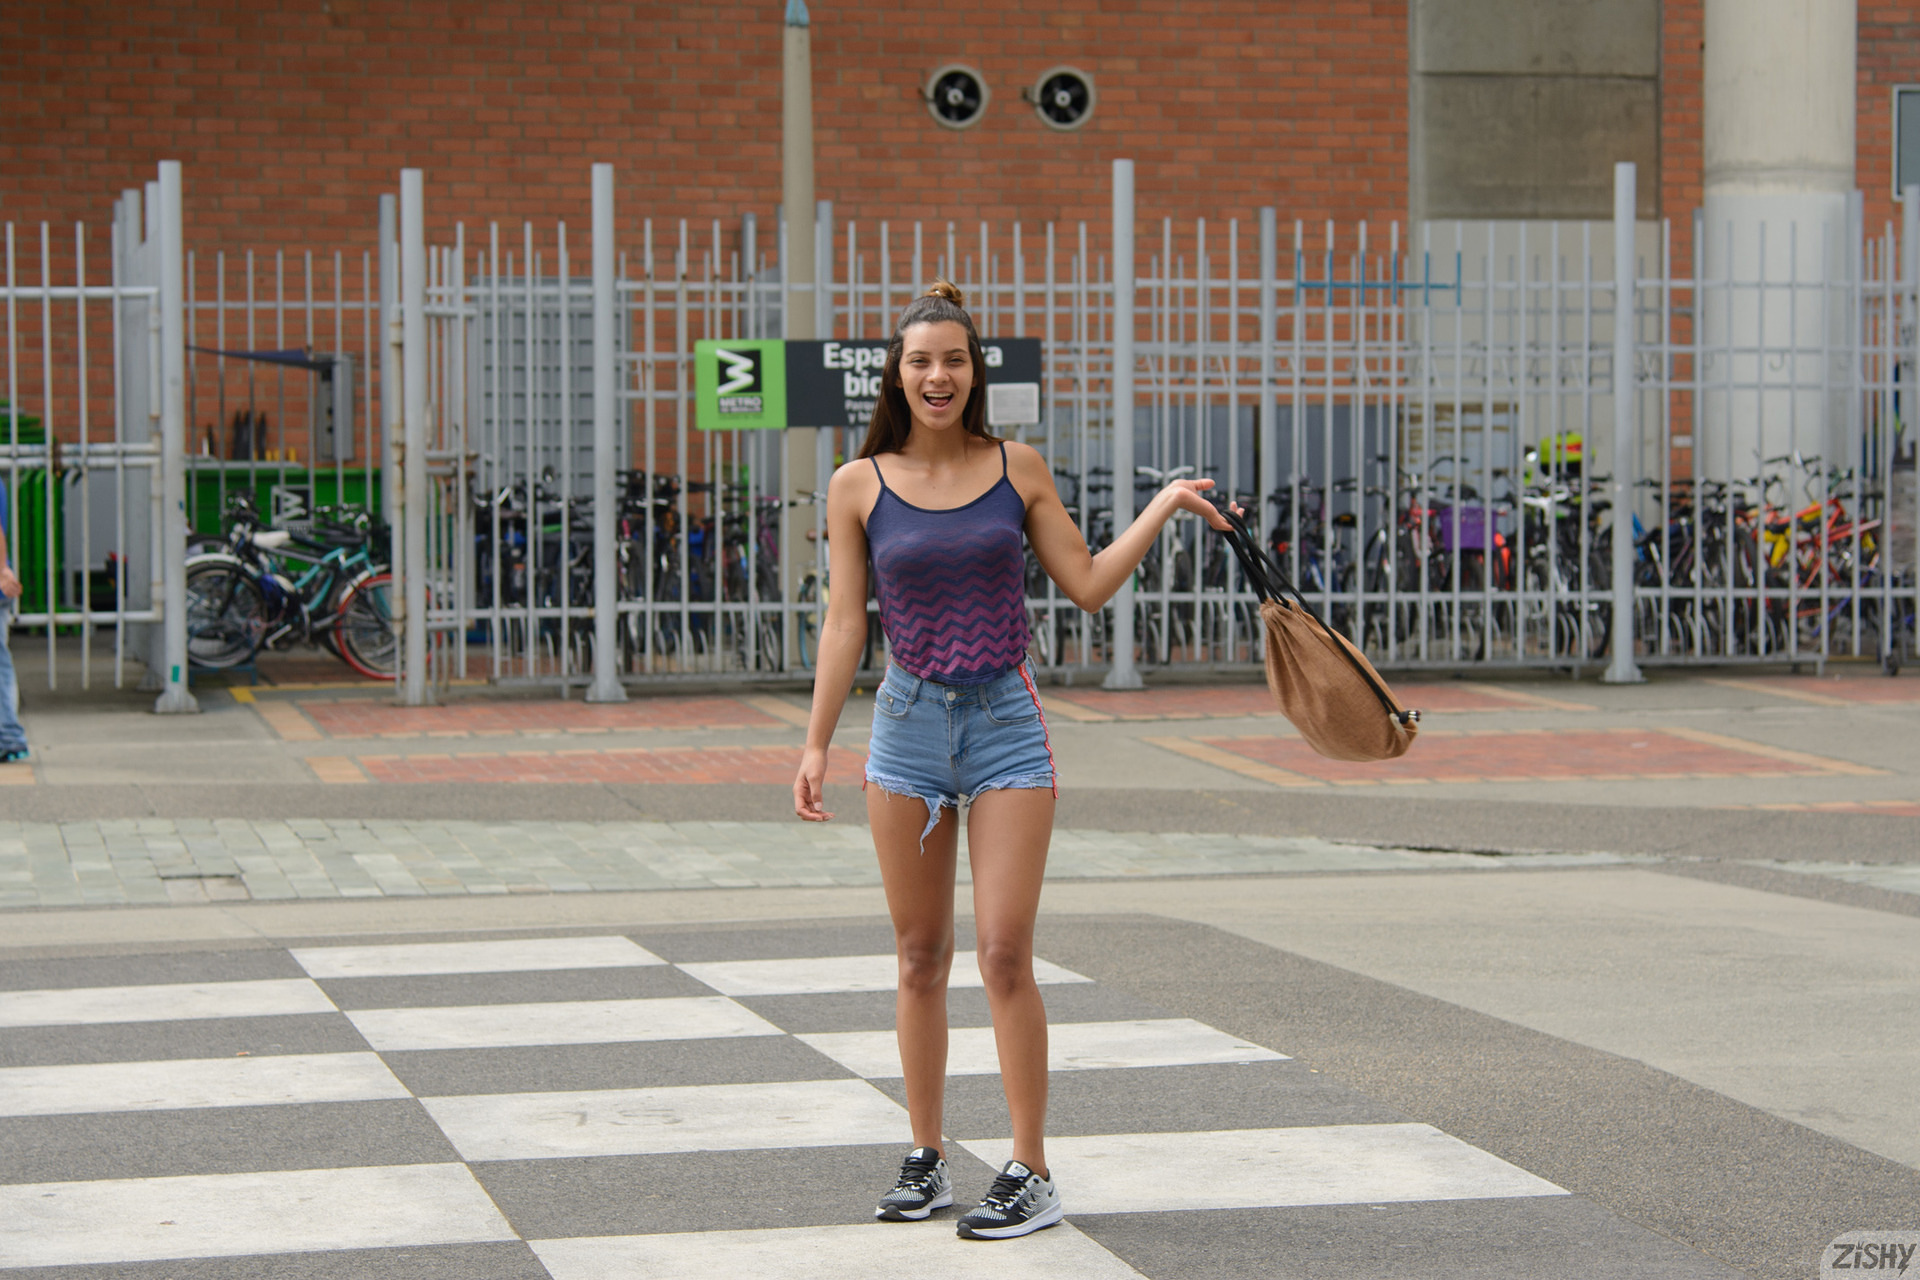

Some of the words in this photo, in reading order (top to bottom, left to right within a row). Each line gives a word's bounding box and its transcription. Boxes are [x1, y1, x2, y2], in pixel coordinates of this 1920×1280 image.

[823, 342, 887, 374] Espa
[844, 370, 883, 397] bic
[719, 396, 763, 407] METRO
